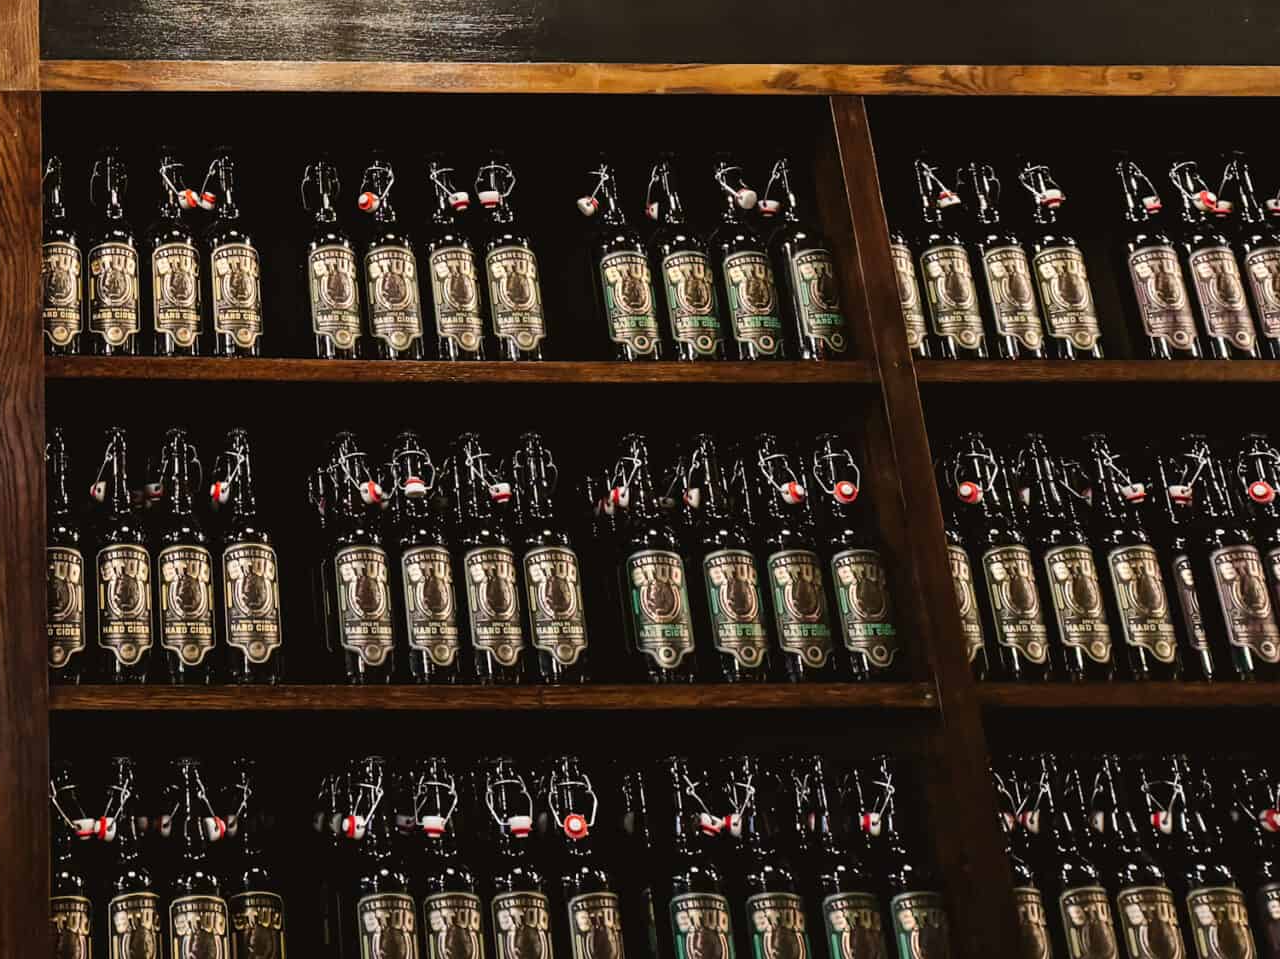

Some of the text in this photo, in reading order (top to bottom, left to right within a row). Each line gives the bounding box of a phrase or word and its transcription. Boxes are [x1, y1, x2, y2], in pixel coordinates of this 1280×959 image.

[91, 255, 136, 274] STUD
[216, 256, 259, 275] STUD
[370, 258, 413, 277] STUD
[491, 259, 536, 279] STUD
[102, 560, 148, 581] STUD
[163, 560, 210, 582] STUD
[227, 559, 275, 580] STUD
[339, 562, 388, 582] STUD
[529, 562, 577, 582] STUD
[633, 566, 682, 586] STUD
[175, 913, 225, 935] STUD
[363, 910, 413, 932] STUD
[430, 909, 480, 931] STUD
[498, 909, 548, 931] STUD
[676, 910, 728, 932] STUD
